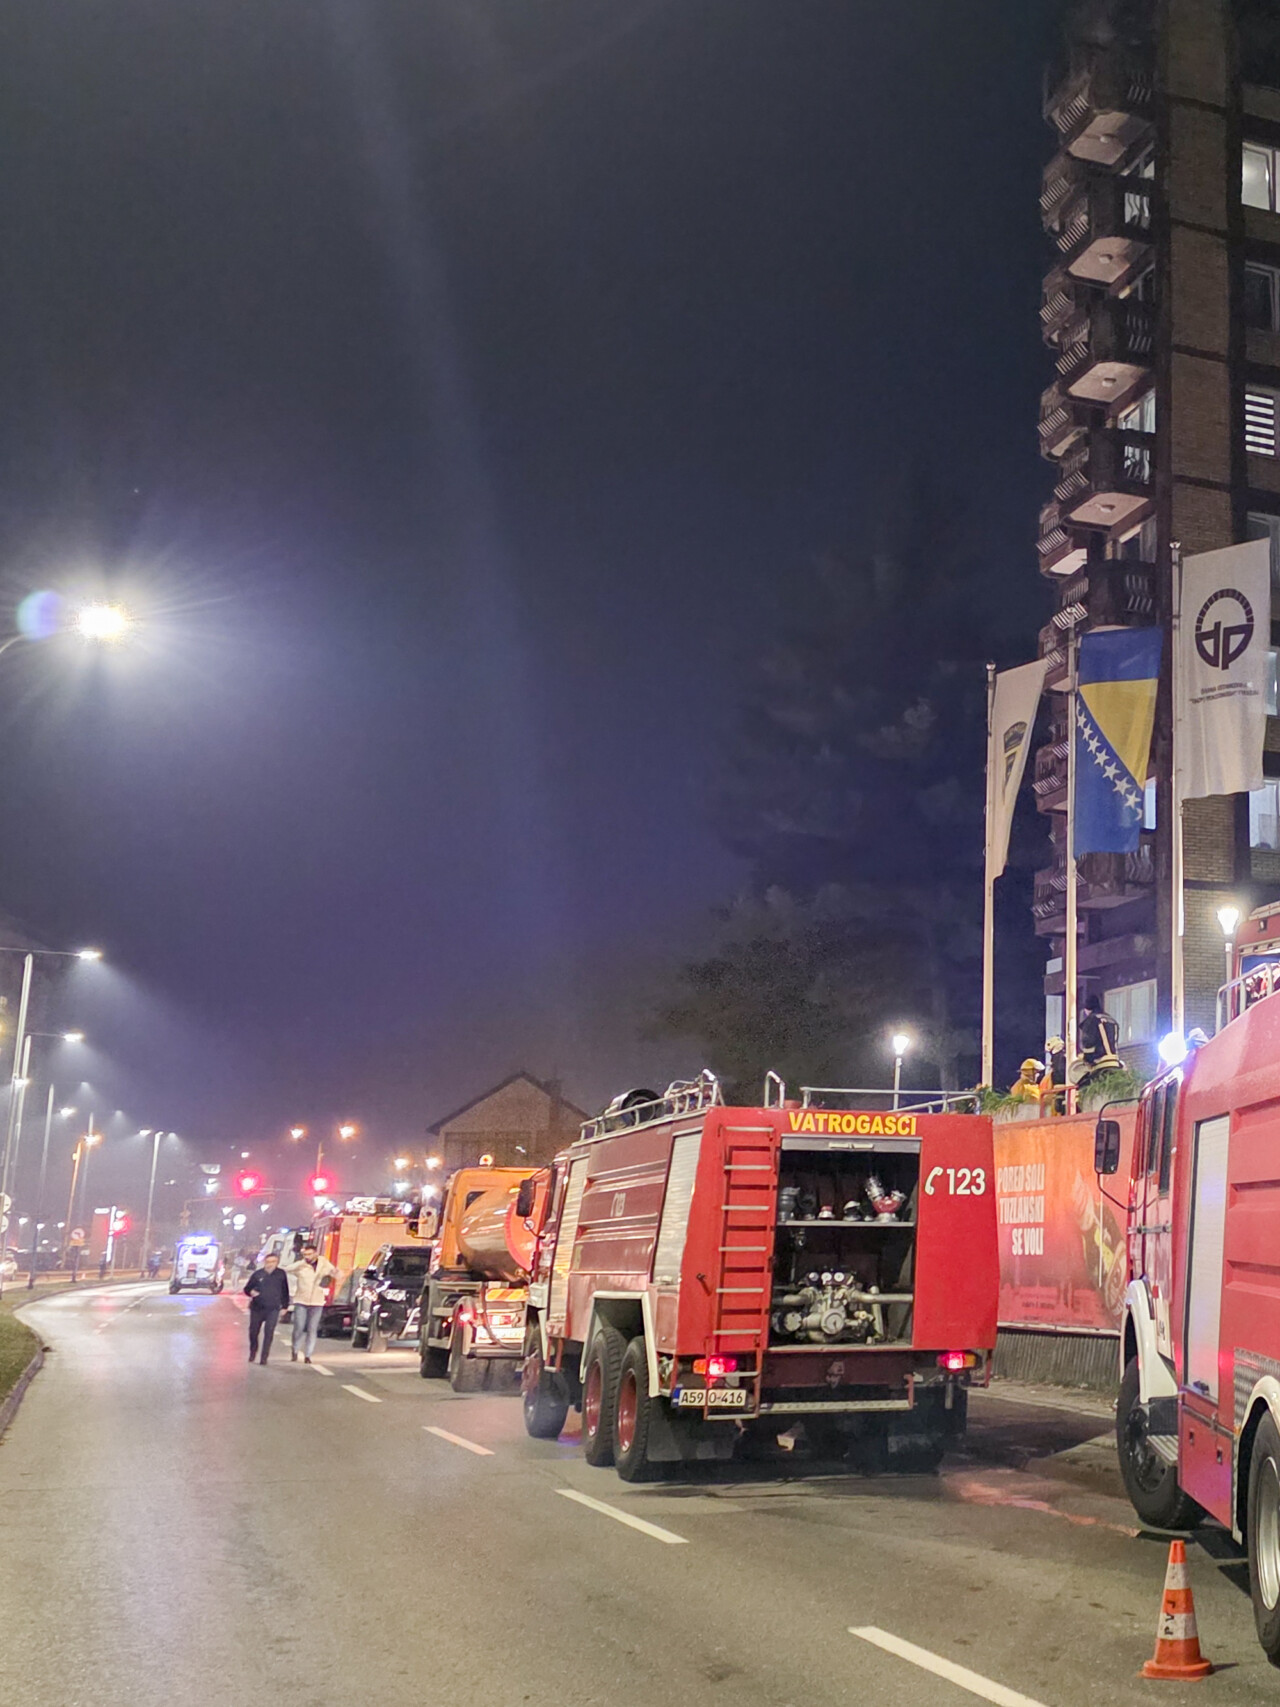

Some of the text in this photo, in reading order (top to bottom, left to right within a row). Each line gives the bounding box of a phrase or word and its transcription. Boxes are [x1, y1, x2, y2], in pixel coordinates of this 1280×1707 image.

[788, 1111, 917, 1136] VATROGASCI
[947, 1167, 986, 1196] 123
[997, 1163, 1045, 1193] PORED SOLI
[1000, 1195, 1045, 1224] TUZLANSKI
[1011, 1227, 1044, 1255] SE VOLI
